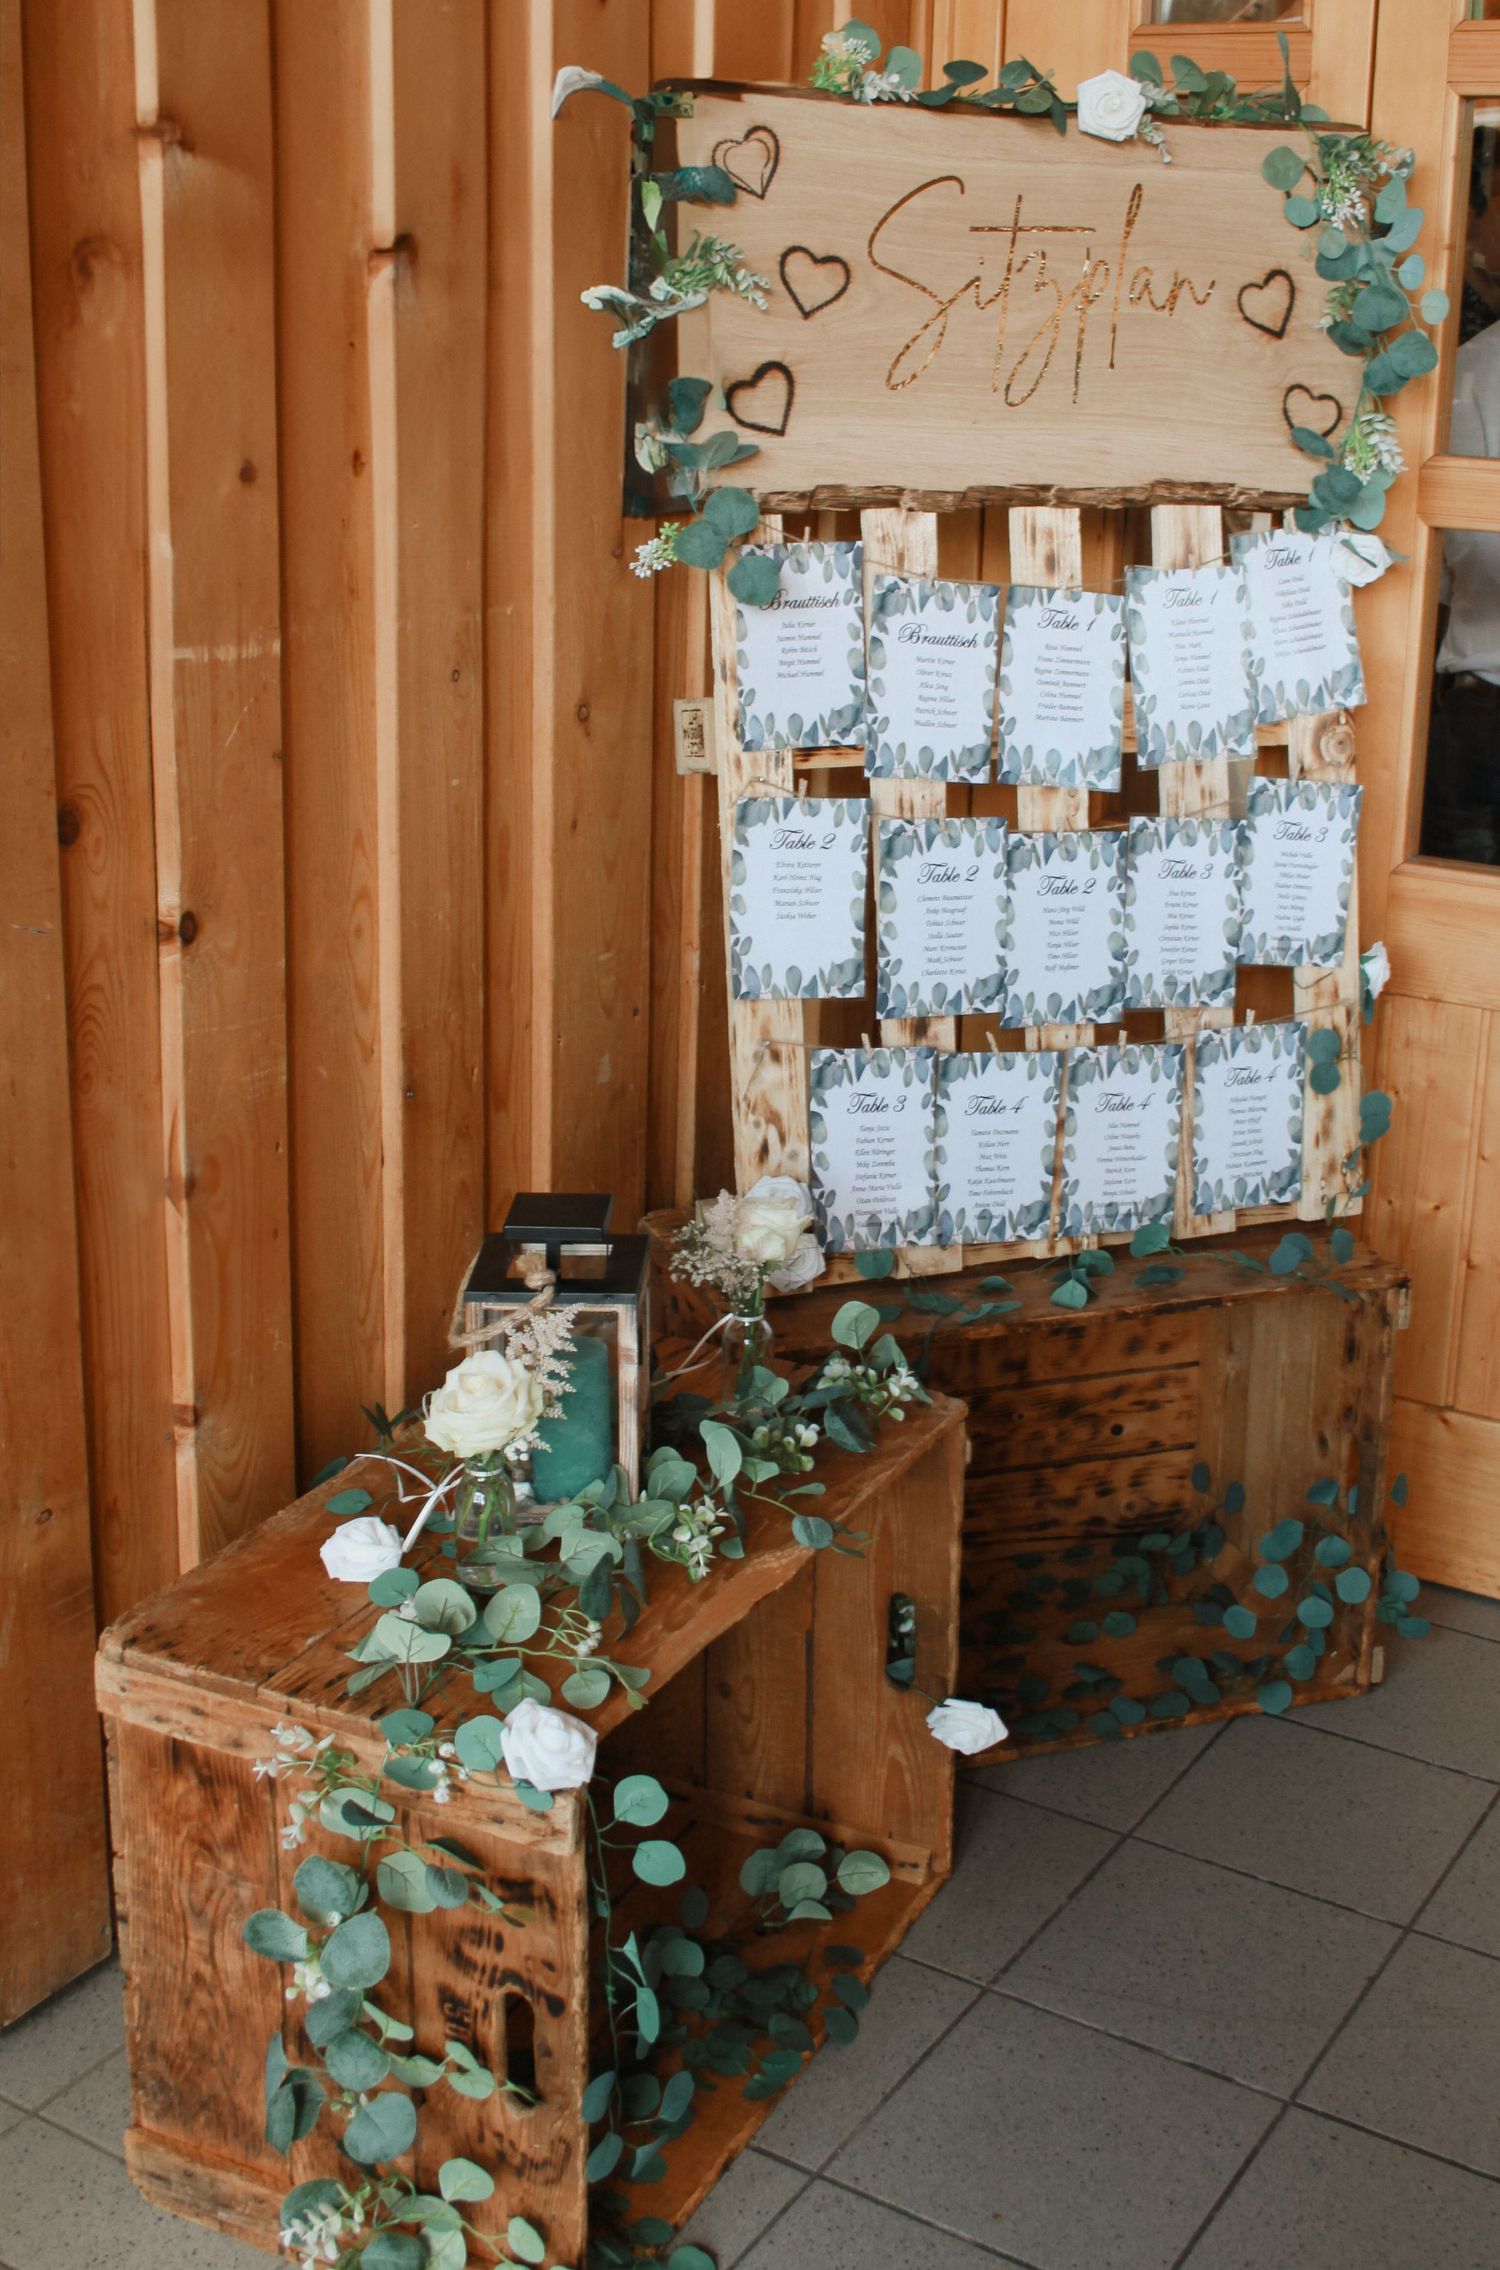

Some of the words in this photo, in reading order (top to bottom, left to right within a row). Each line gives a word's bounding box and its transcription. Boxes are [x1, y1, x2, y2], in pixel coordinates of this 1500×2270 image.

[867, 175, 1216, 407] Sitzplan
[1264, 548, 1300, 570] Table
[1308, 547, 1316, 562] 1
[760, 588, 841, 611] Brauttisch
[1163, 588, 1202, 608] Table
[1210, 591, 1218, 605] 1
[1037, 608, 1079, 631] Table
[1086, 618, 1097, 631] 1
[898, 622, 980, 648] Brauttisch
[769, 828, 816, 850] Table
[820, 833, 836, 850] 2
[1273, 821, 1311, 841] Table
[1315, 827, 1328, 843] 3
[917, 863, 961, 884] Table
[965, 865, 979, 882] 2
[1158, 859, 1197, 879] Table
[1200, 863, 1214, 879] 3
[1037, 875, 1078, 896] Table
[1082, 878, 1097, 894] 2
[1224, 1066, 1262, 1087] Table
[1264, 1065, 1282, 1082] 4
[847, 1092, 889, 1114] Table
[893, 1095, 907, 1113] 3
[964, 1095, 1007, 1115] Table
[1009, 1096, 1029, 1113] 4
[1095, 1092, 1135, 1113] Table
[1137, 1093, 1156, 1110] 4
